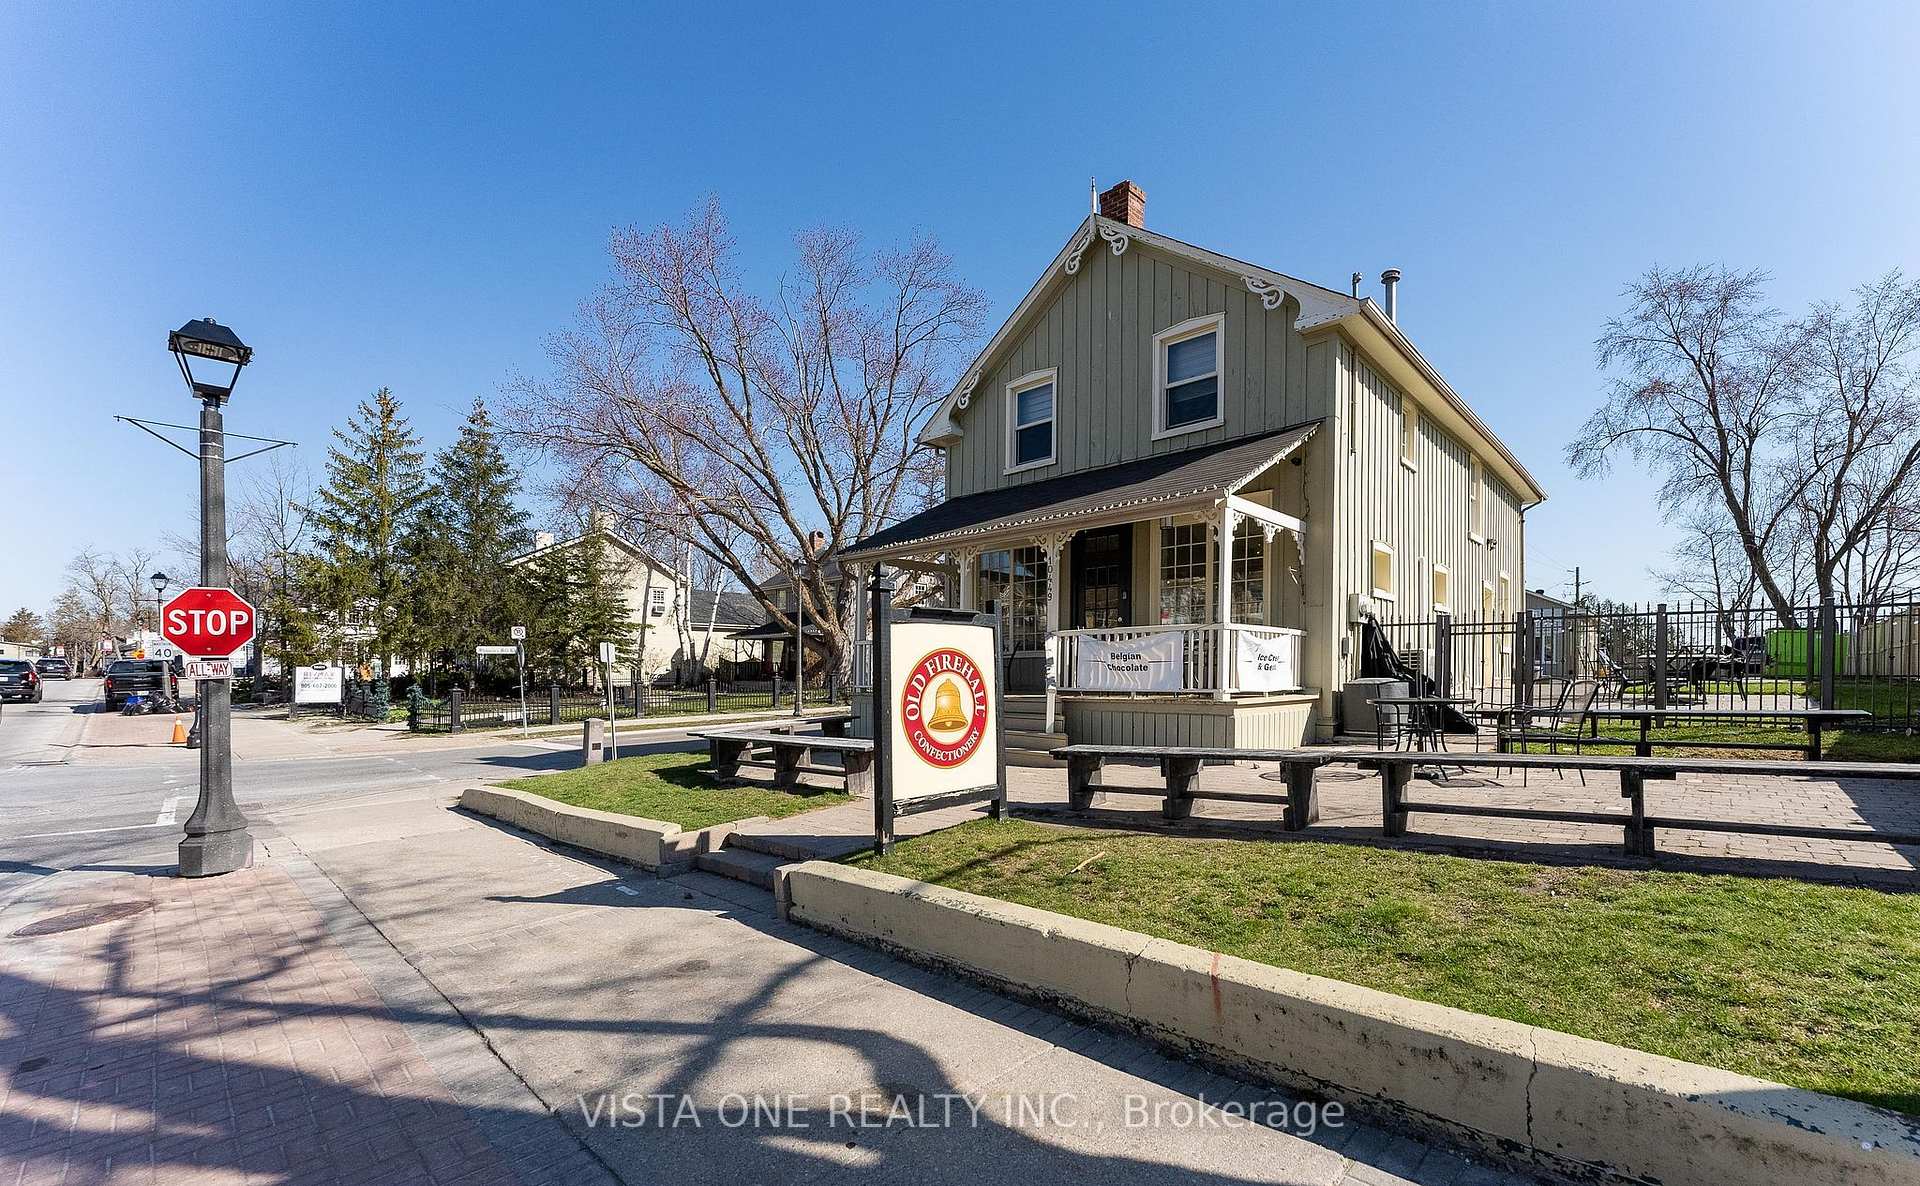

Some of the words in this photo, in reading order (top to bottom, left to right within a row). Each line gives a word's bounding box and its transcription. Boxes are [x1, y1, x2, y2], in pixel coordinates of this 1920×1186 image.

[168, 609, 249, 636] STOP
[154, 648, 172, 658] 40
[1110, 652, 1141, 662] Belgian
[1257, 653, 1267, 661] Ice
[1107, 663, 1149, 672] Chocolate
[1257, 662, 1263, 670] &
[906, 673, 926, 721] OLD
[925, 654, 986, 718] FIREHALL
[914, 728, 980, 761] CONFECTIONERY
